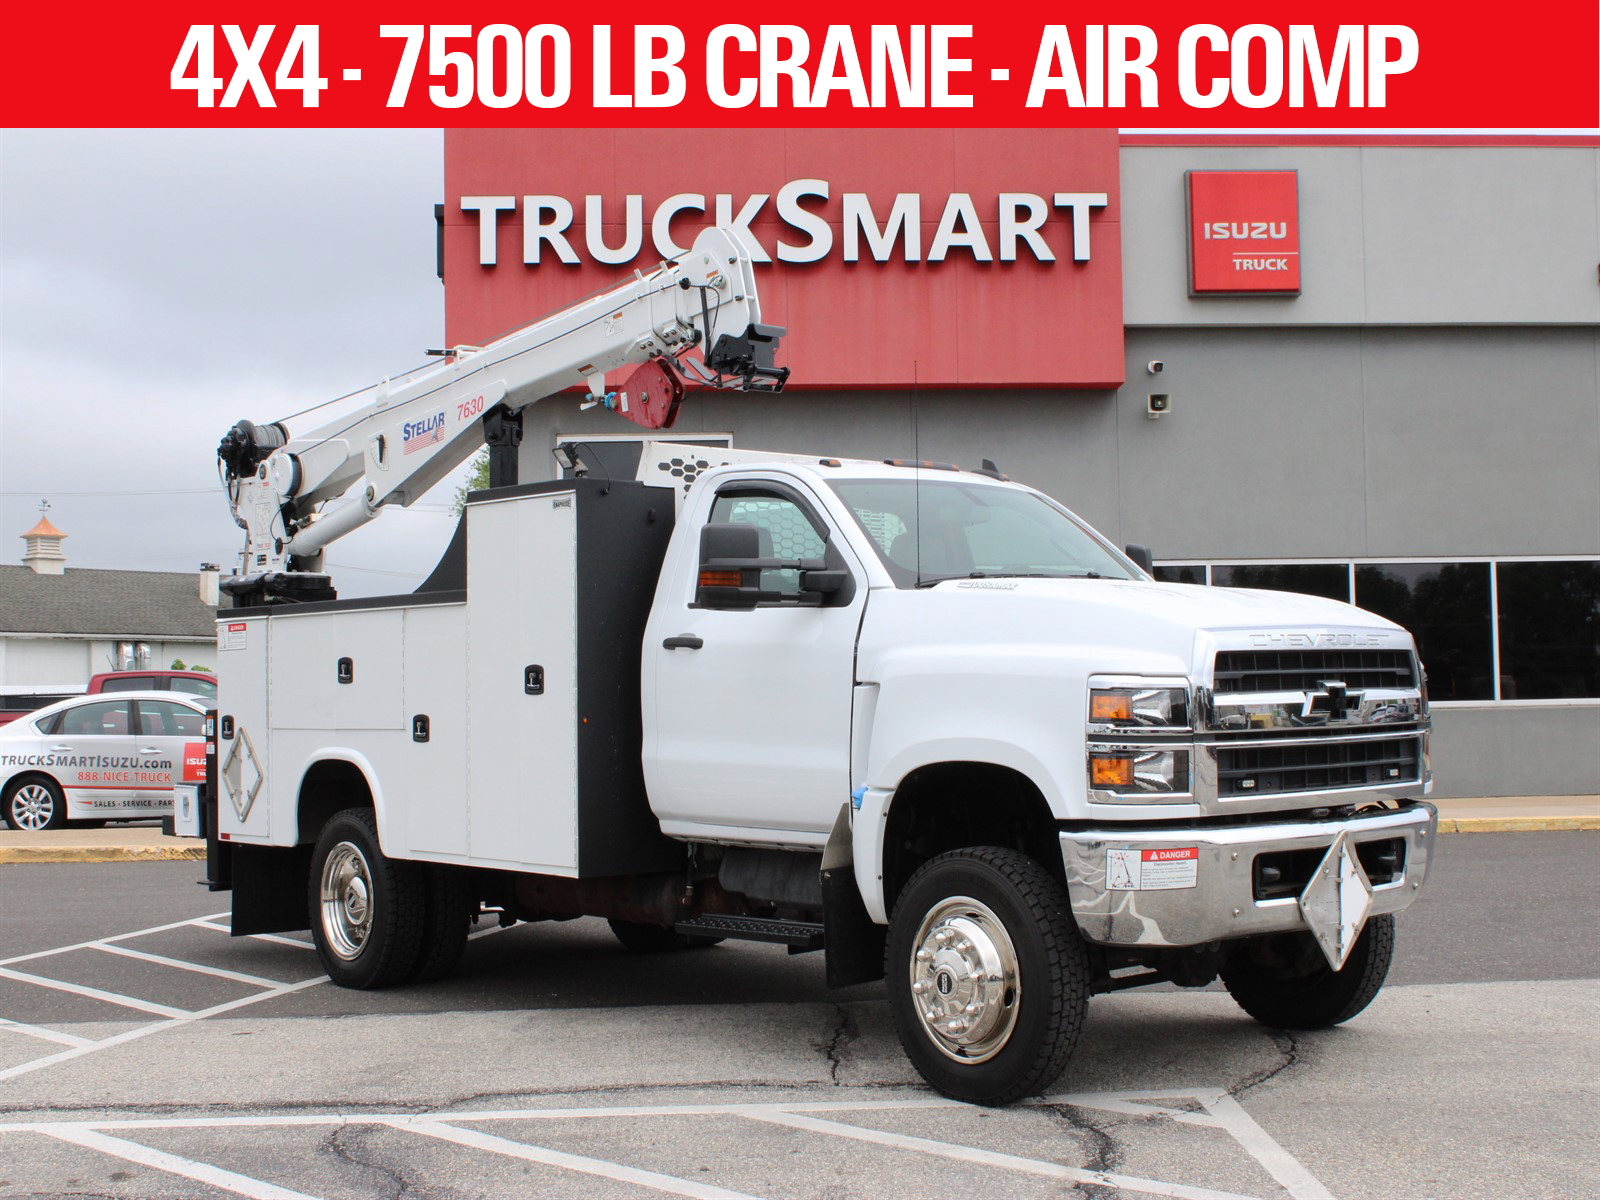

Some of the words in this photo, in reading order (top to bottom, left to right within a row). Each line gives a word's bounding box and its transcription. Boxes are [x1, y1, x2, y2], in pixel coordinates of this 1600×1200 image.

[460, 179, 1108, 266] TRUCKSMART
[1203, 222, 1288, 239] ISUZU
[1232, 258, 1288, 271] TRUCK
[457, 396, 484, 421] 7630
[403, 411, 445, 441] STELLAR
[1249, 634, 1389, 647] CHEVROLET
[94, 800, 116, 808] SALES
[1160, 850, 1191, 859] DANGER
